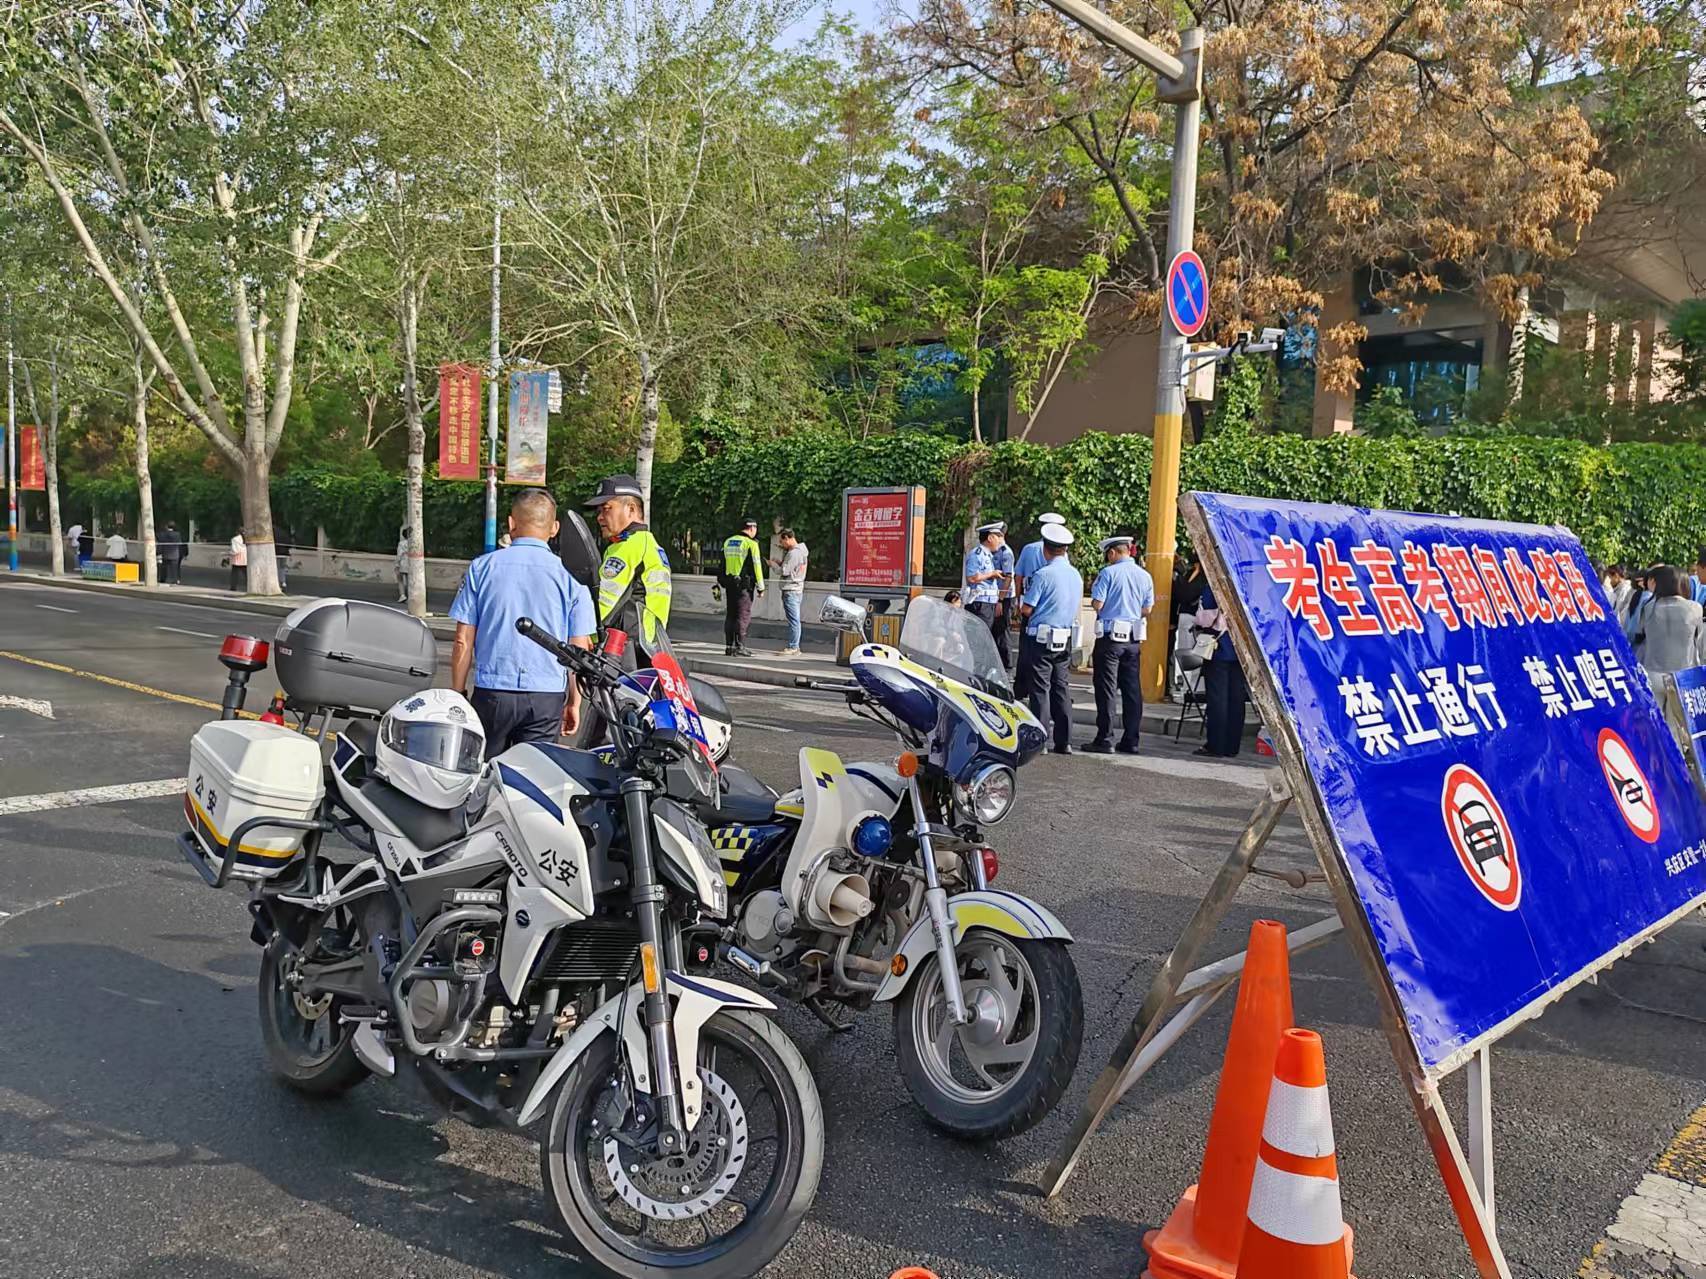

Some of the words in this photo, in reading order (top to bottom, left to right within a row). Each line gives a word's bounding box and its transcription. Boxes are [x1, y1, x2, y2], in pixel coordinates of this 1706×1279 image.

[1265, 535, 1606, 641] 考生高考期间此路段
[1338, 663, 1507, 758] 禁止通行
[1523, 647, 1633, 718] 禁止鸣号
[195, 774, 219, 816] 公安
[494, 830, 528, 879] CFMOTO
[539, 849, 579, 887] 公安
